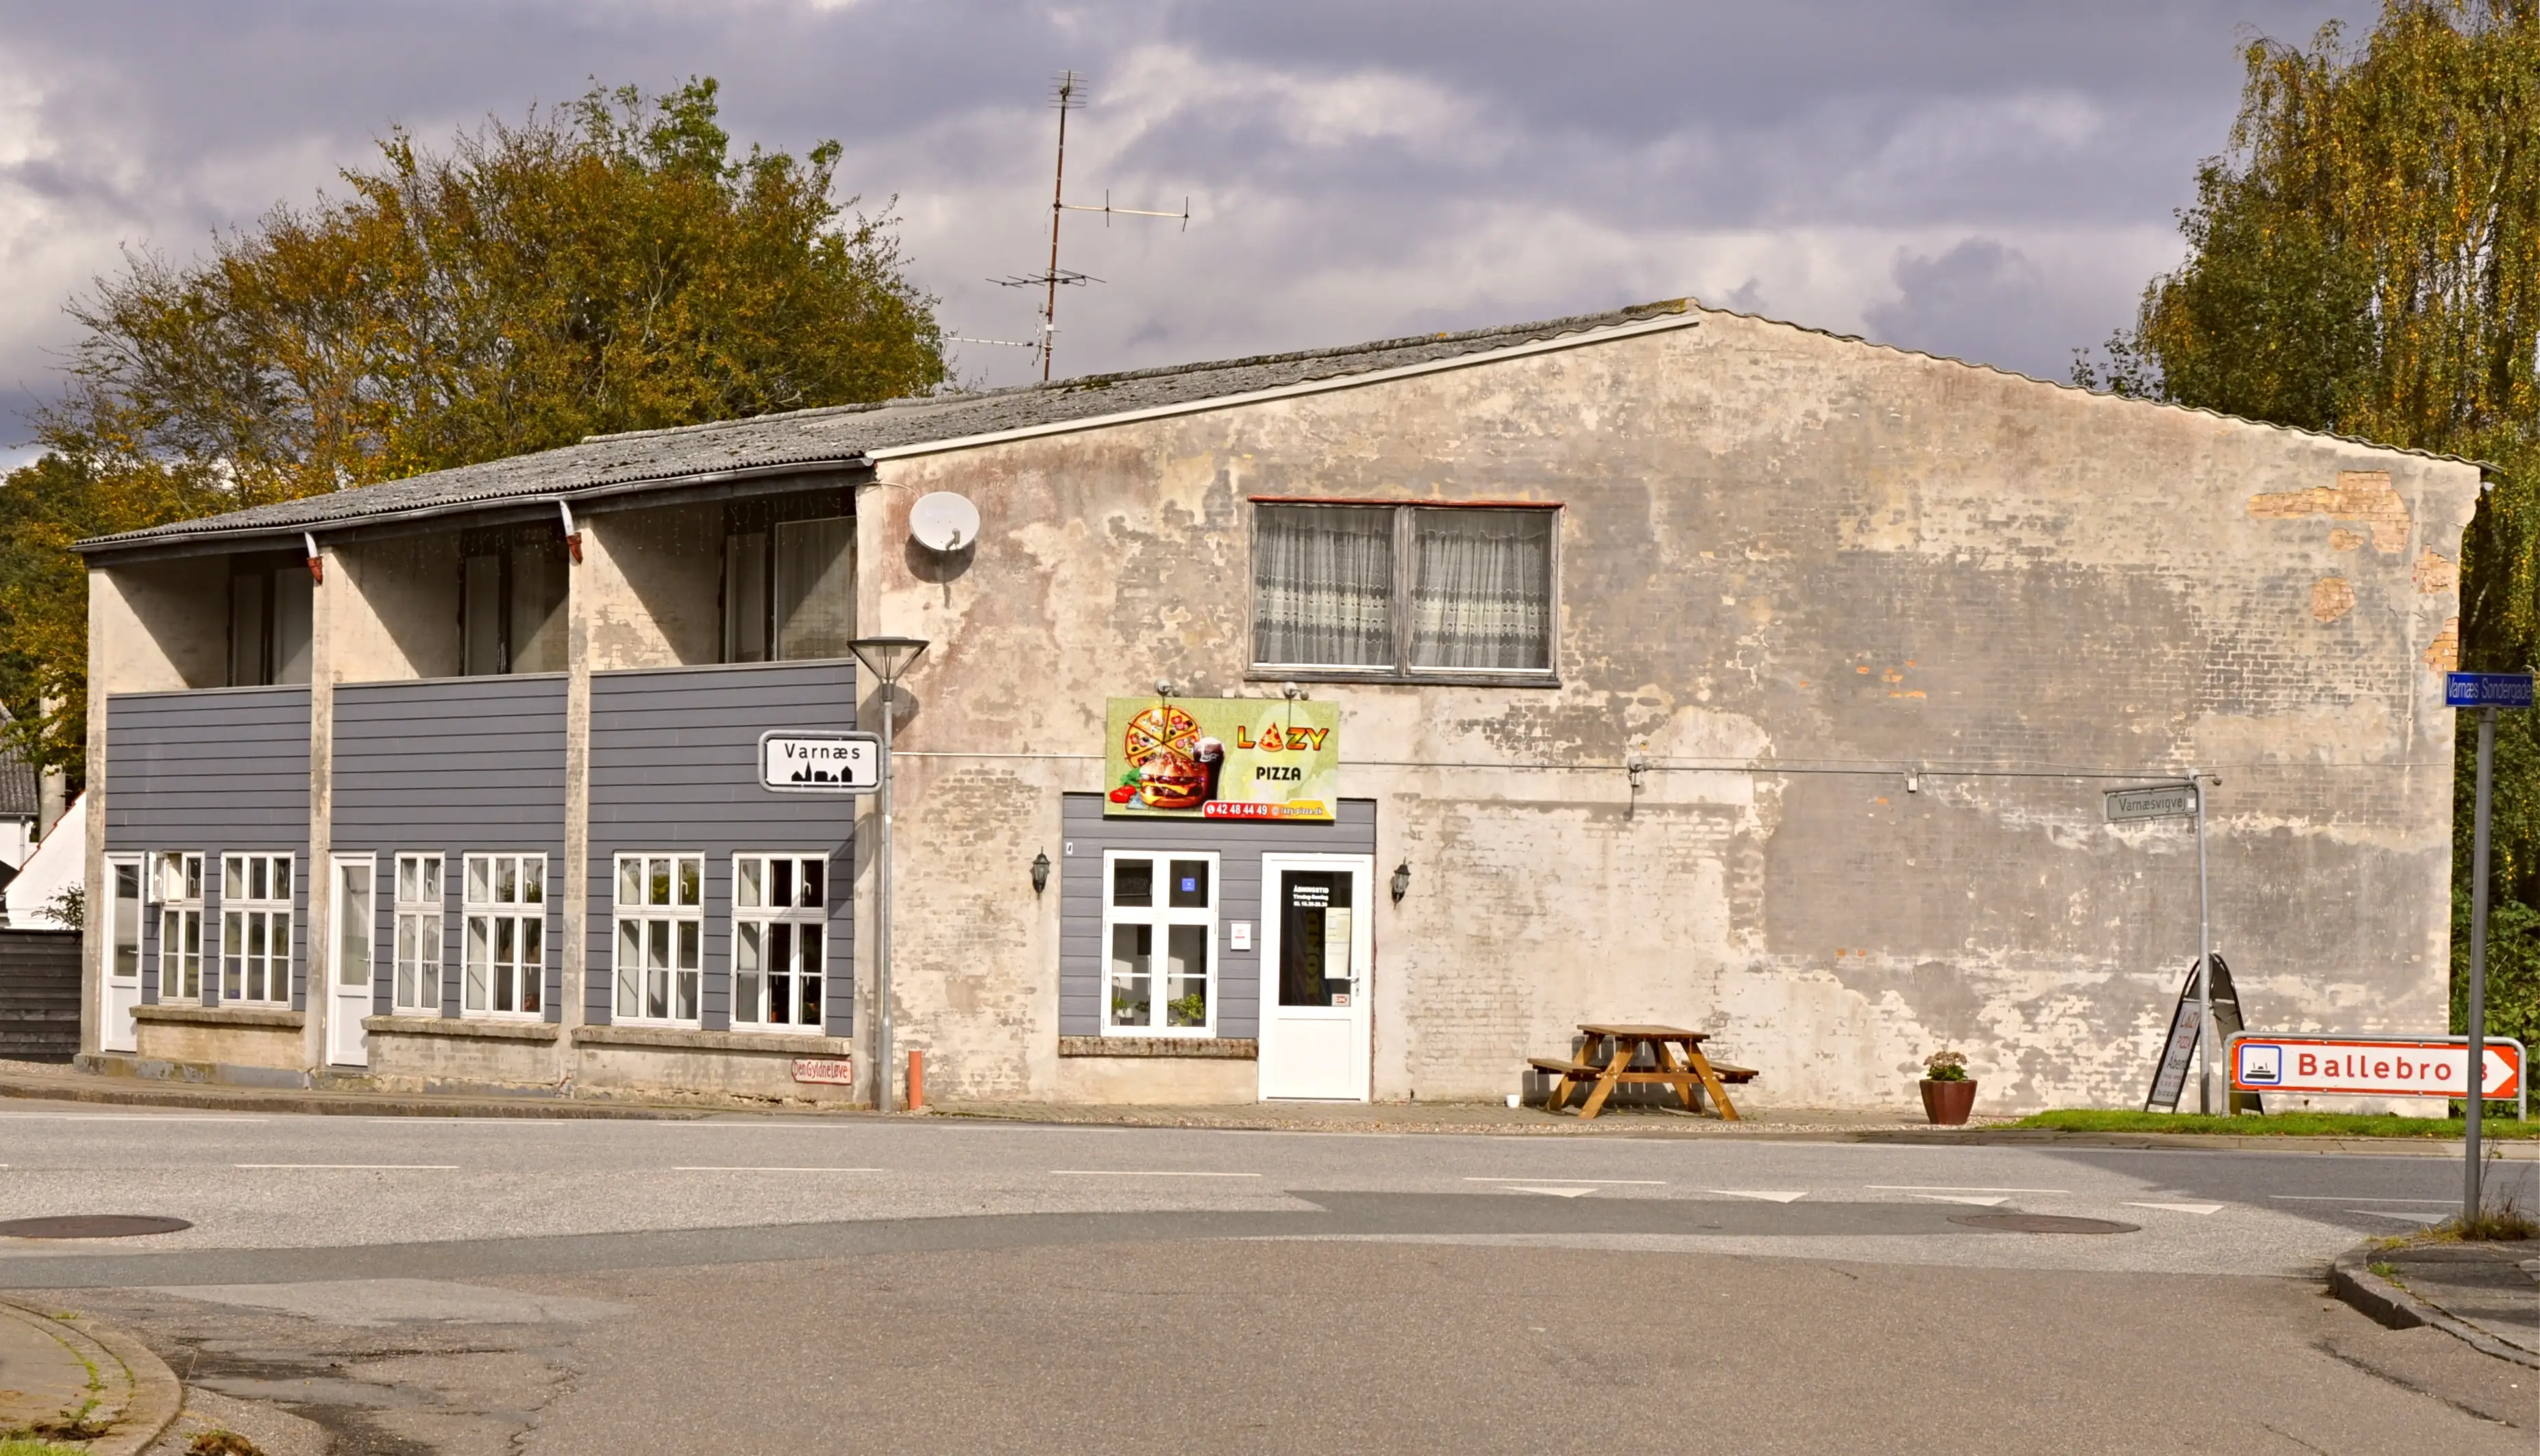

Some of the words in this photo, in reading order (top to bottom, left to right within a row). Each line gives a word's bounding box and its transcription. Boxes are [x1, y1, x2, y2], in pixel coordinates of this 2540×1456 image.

[2447, 676, 2478, 698] Varnæs
[785, 743, 861, 759] Varnæs
[1256, 767, 1301, 781] PIZZA
[1216, 804, 1227, 815] 42
[1230, 804, 1241, 815] 48
[1243, 804, 1255, 815] 44
[1256, 804, 1268, 815] 49
[2119, 797, 2186, 813] Varnæsvigvej
[2299, 1053, 2452, 1081] Ballebro
